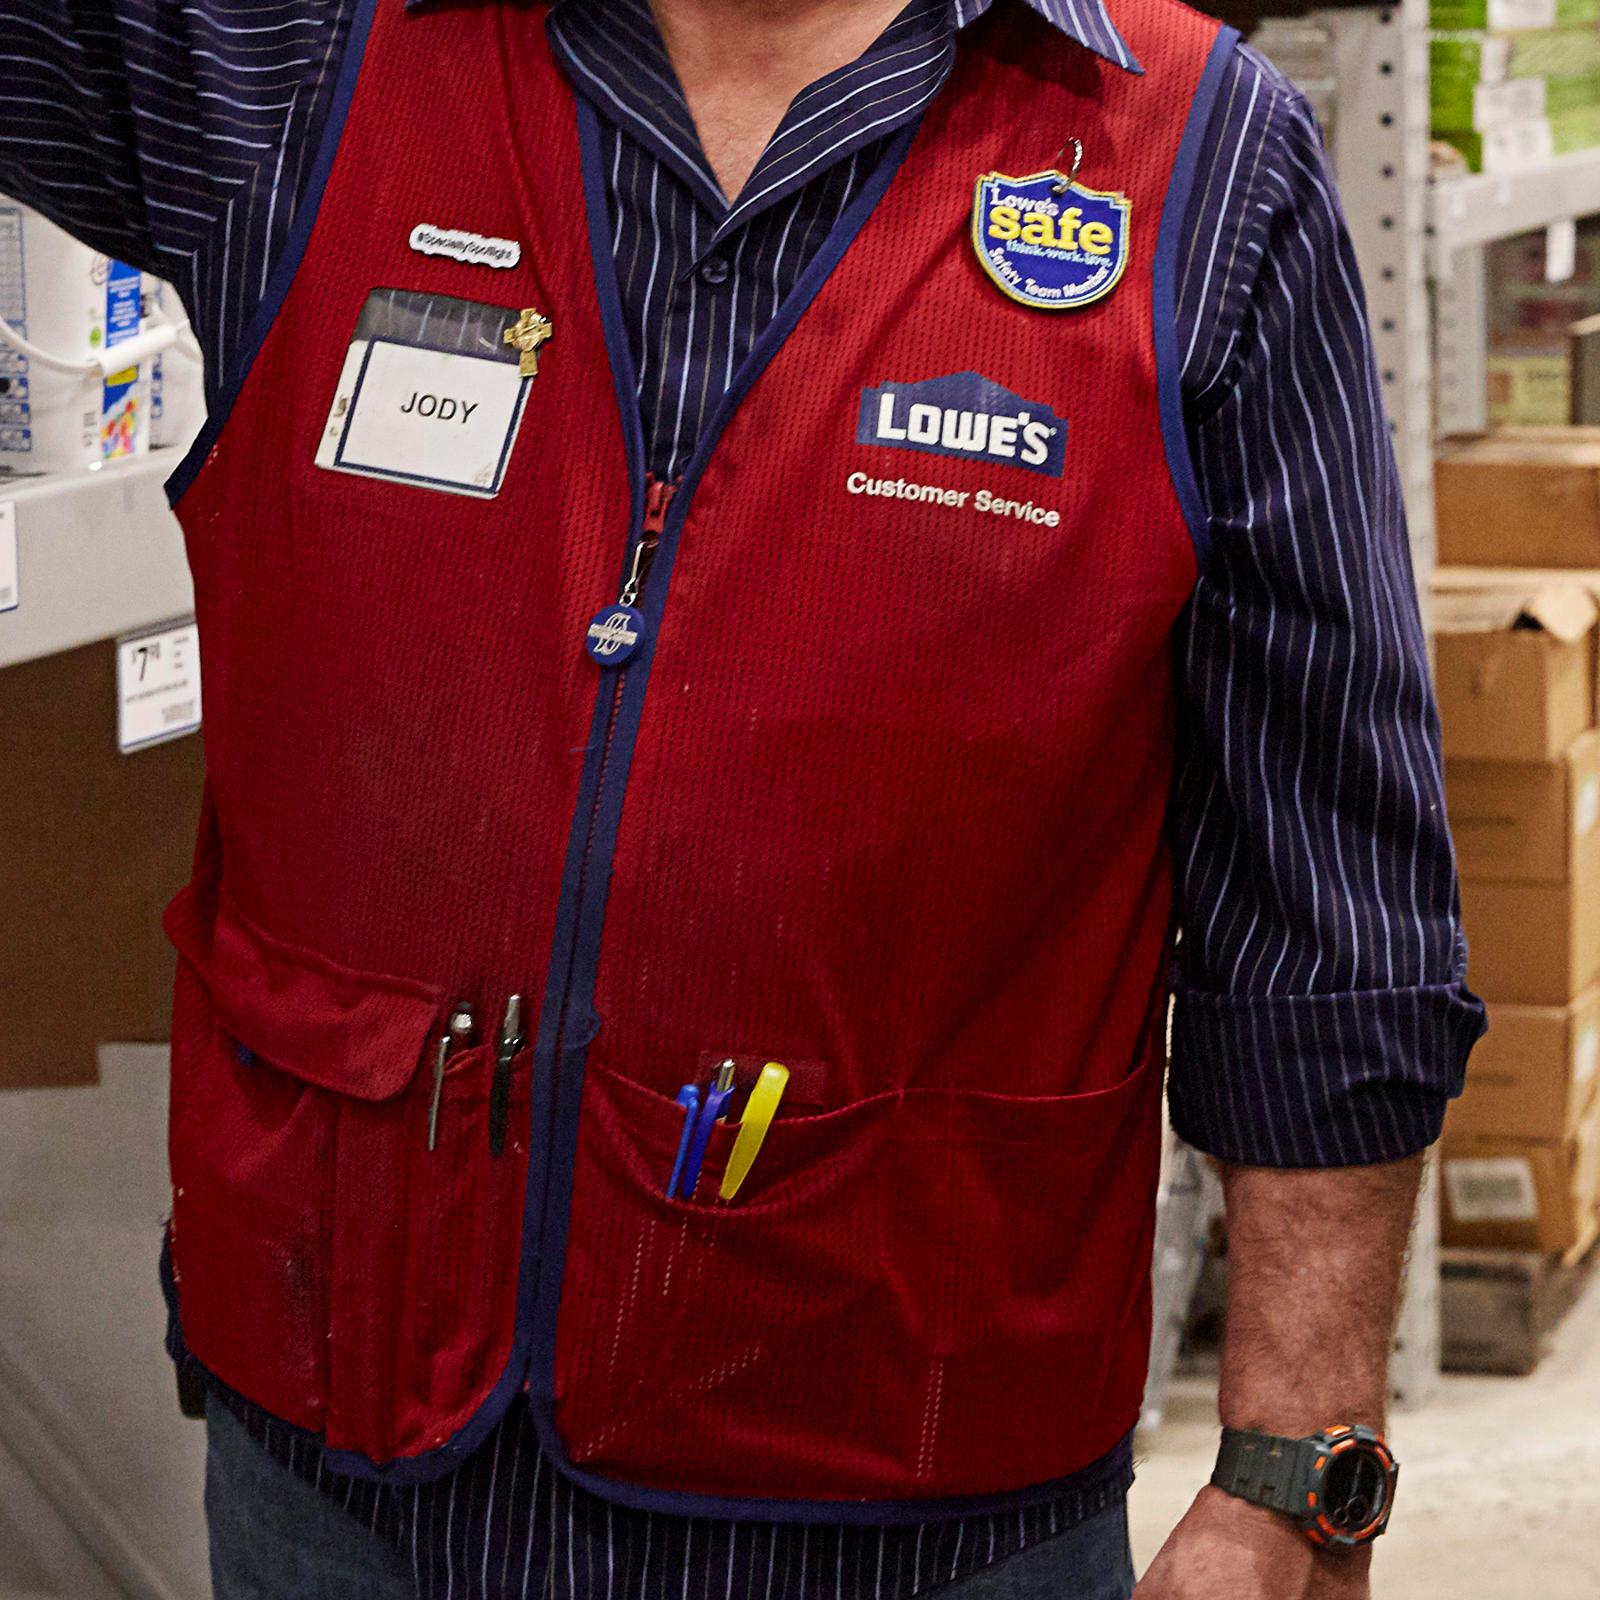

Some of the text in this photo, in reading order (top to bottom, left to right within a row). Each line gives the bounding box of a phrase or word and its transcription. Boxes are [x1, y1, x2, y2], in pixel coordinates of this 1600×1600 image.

[990, 186, 1059, 217] Lowe's
[988, 206, 1113, 255] safe
[989, 248, 1022, 286] Safety
[1025, 278, 1062, 298] Team
[401, 392, 478, 424] JODY
[876, 393, 1052, 466] LOWE'S
[846, 471, 1061, 528] Customer Service
